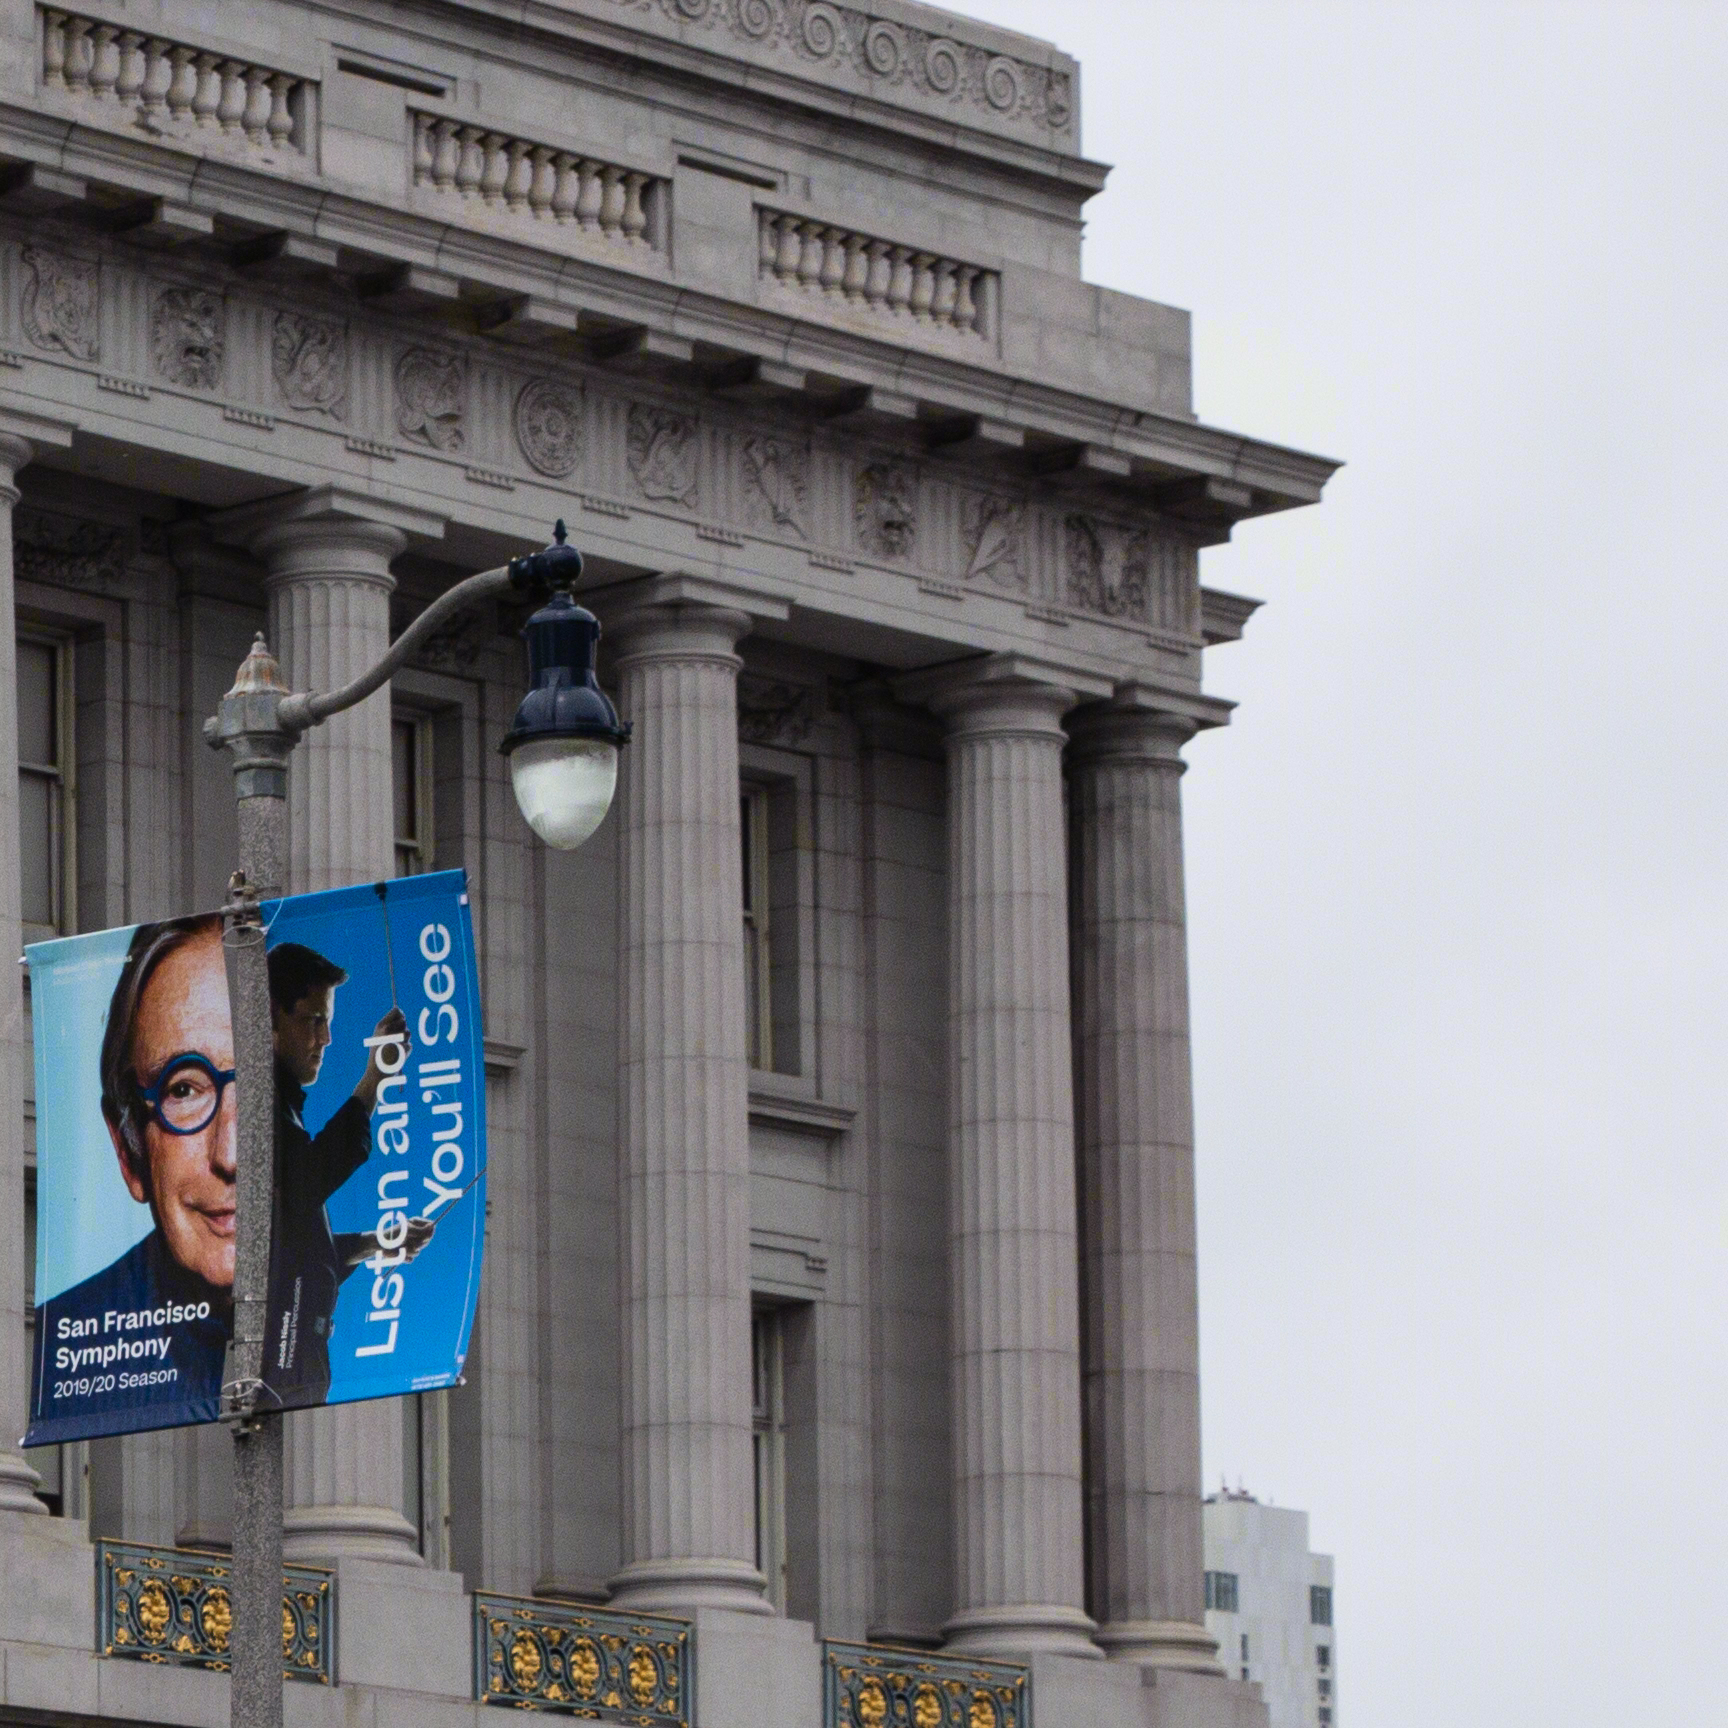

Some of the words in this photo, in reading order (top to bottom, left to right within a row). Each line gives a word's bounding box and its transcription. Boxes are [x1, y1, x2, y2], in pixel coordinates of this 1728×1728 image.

[418, 922, 459, 1047] See
[363, 1033, 410, 1156] and
[418, 1059, 464, 1218] You'll
[57, 1317, 98, 1340] San
[104, 1300, 211, 1333] Francisco
[355, 1170, 409, 1358] Listen
[53, 1373, 116, 1399] 2019/20
[118, 1367, 178, 1390] Season
[55, 1336, 172, 1373] Symphony
